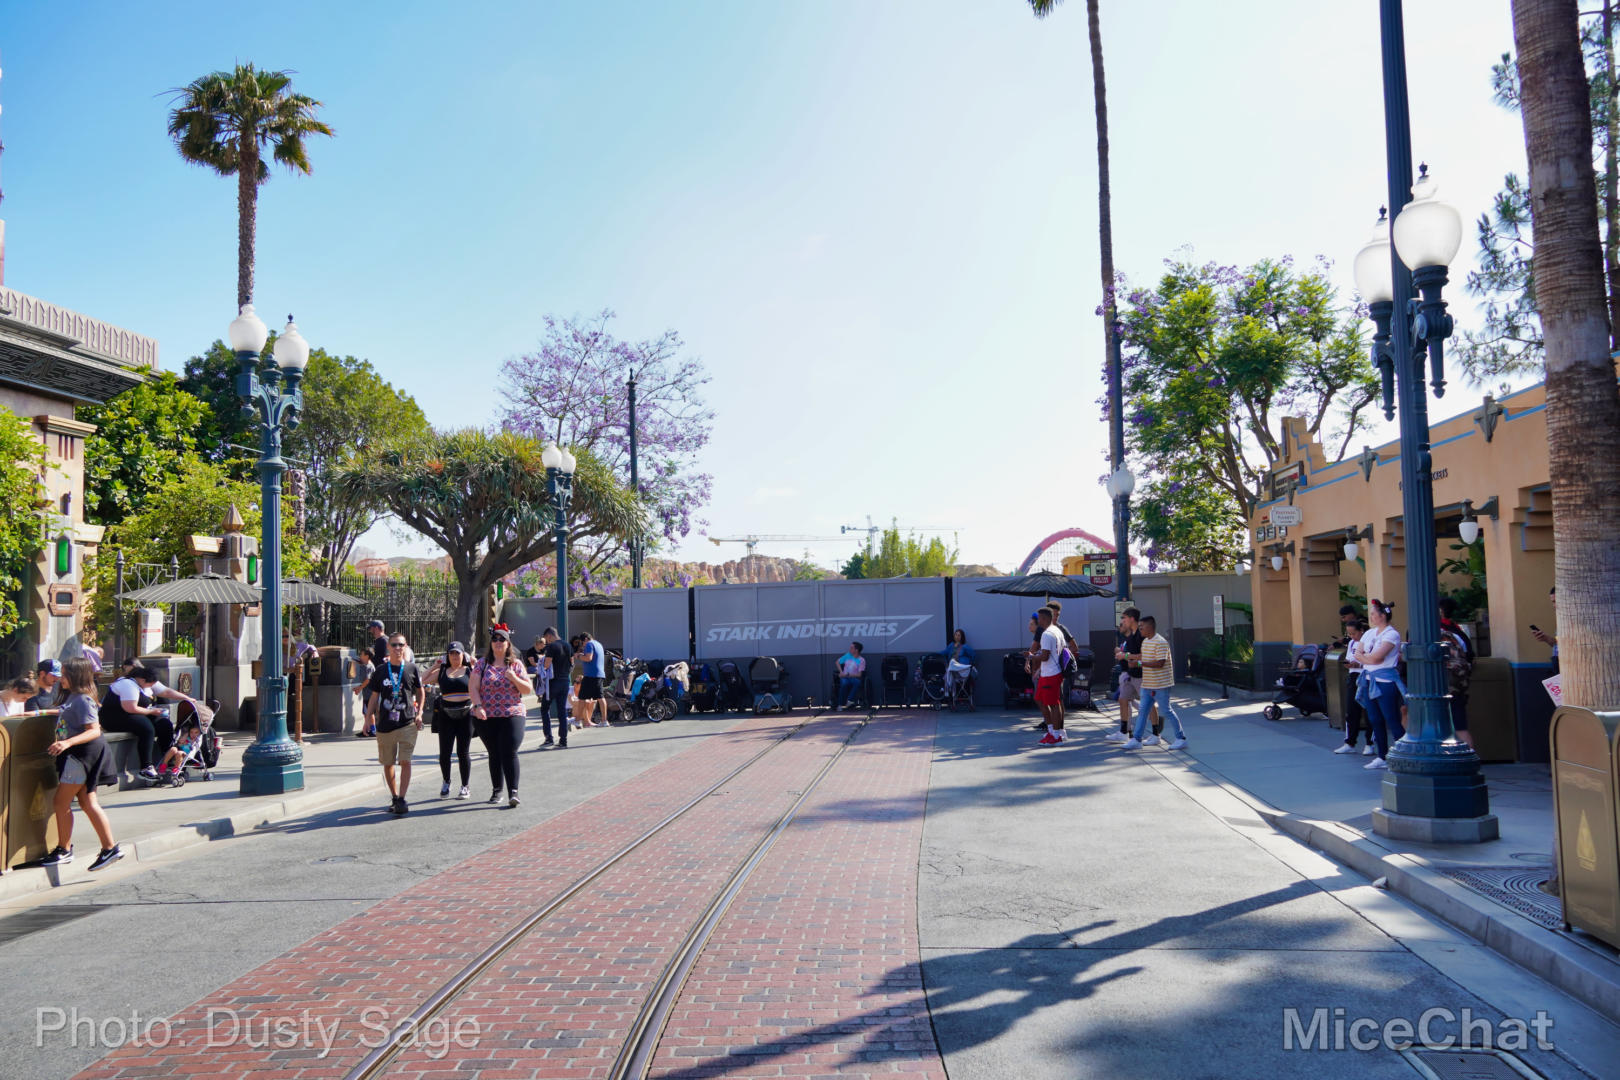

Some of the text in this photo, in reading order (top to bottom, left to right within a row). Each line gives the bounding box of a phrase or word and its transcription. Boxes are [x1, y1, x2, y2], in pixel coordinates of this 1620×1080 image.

[1431, 468, 1448, 481] CKETS
[706, 622, 898, 642] STARK INDUSTRIES
